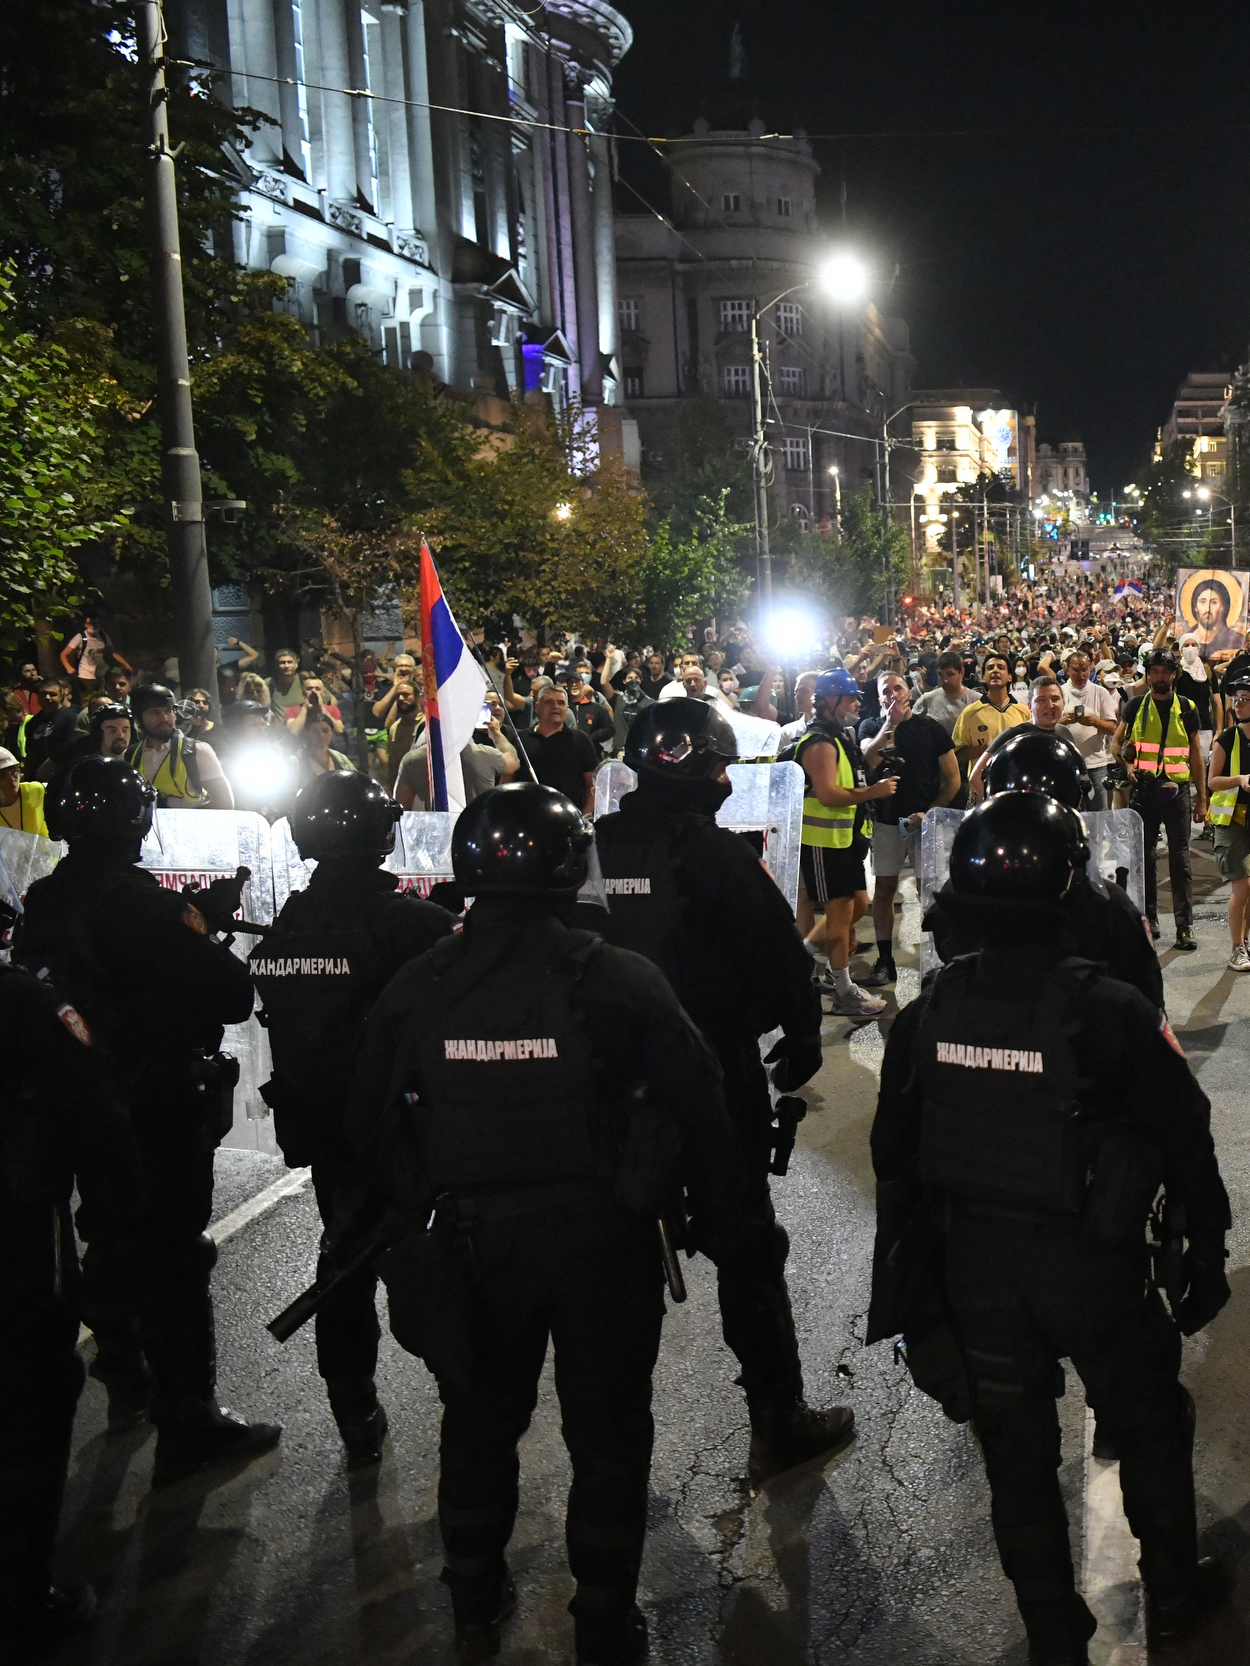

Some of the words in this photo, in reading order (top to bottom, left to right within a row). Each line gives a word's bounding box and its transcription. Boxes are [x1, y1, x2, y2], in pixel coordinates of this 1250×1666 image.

[602, 878, 651, 894] АРМЕРИЈА
[249, 958, 350, 977] ЖАНДАРМЕРИЈА
[444, 1038, 558, 1061] ЖАНДАРМЕРИЈА
[936, 1041, 1043, 1073] ЖАНДАРМЕРИЈА
